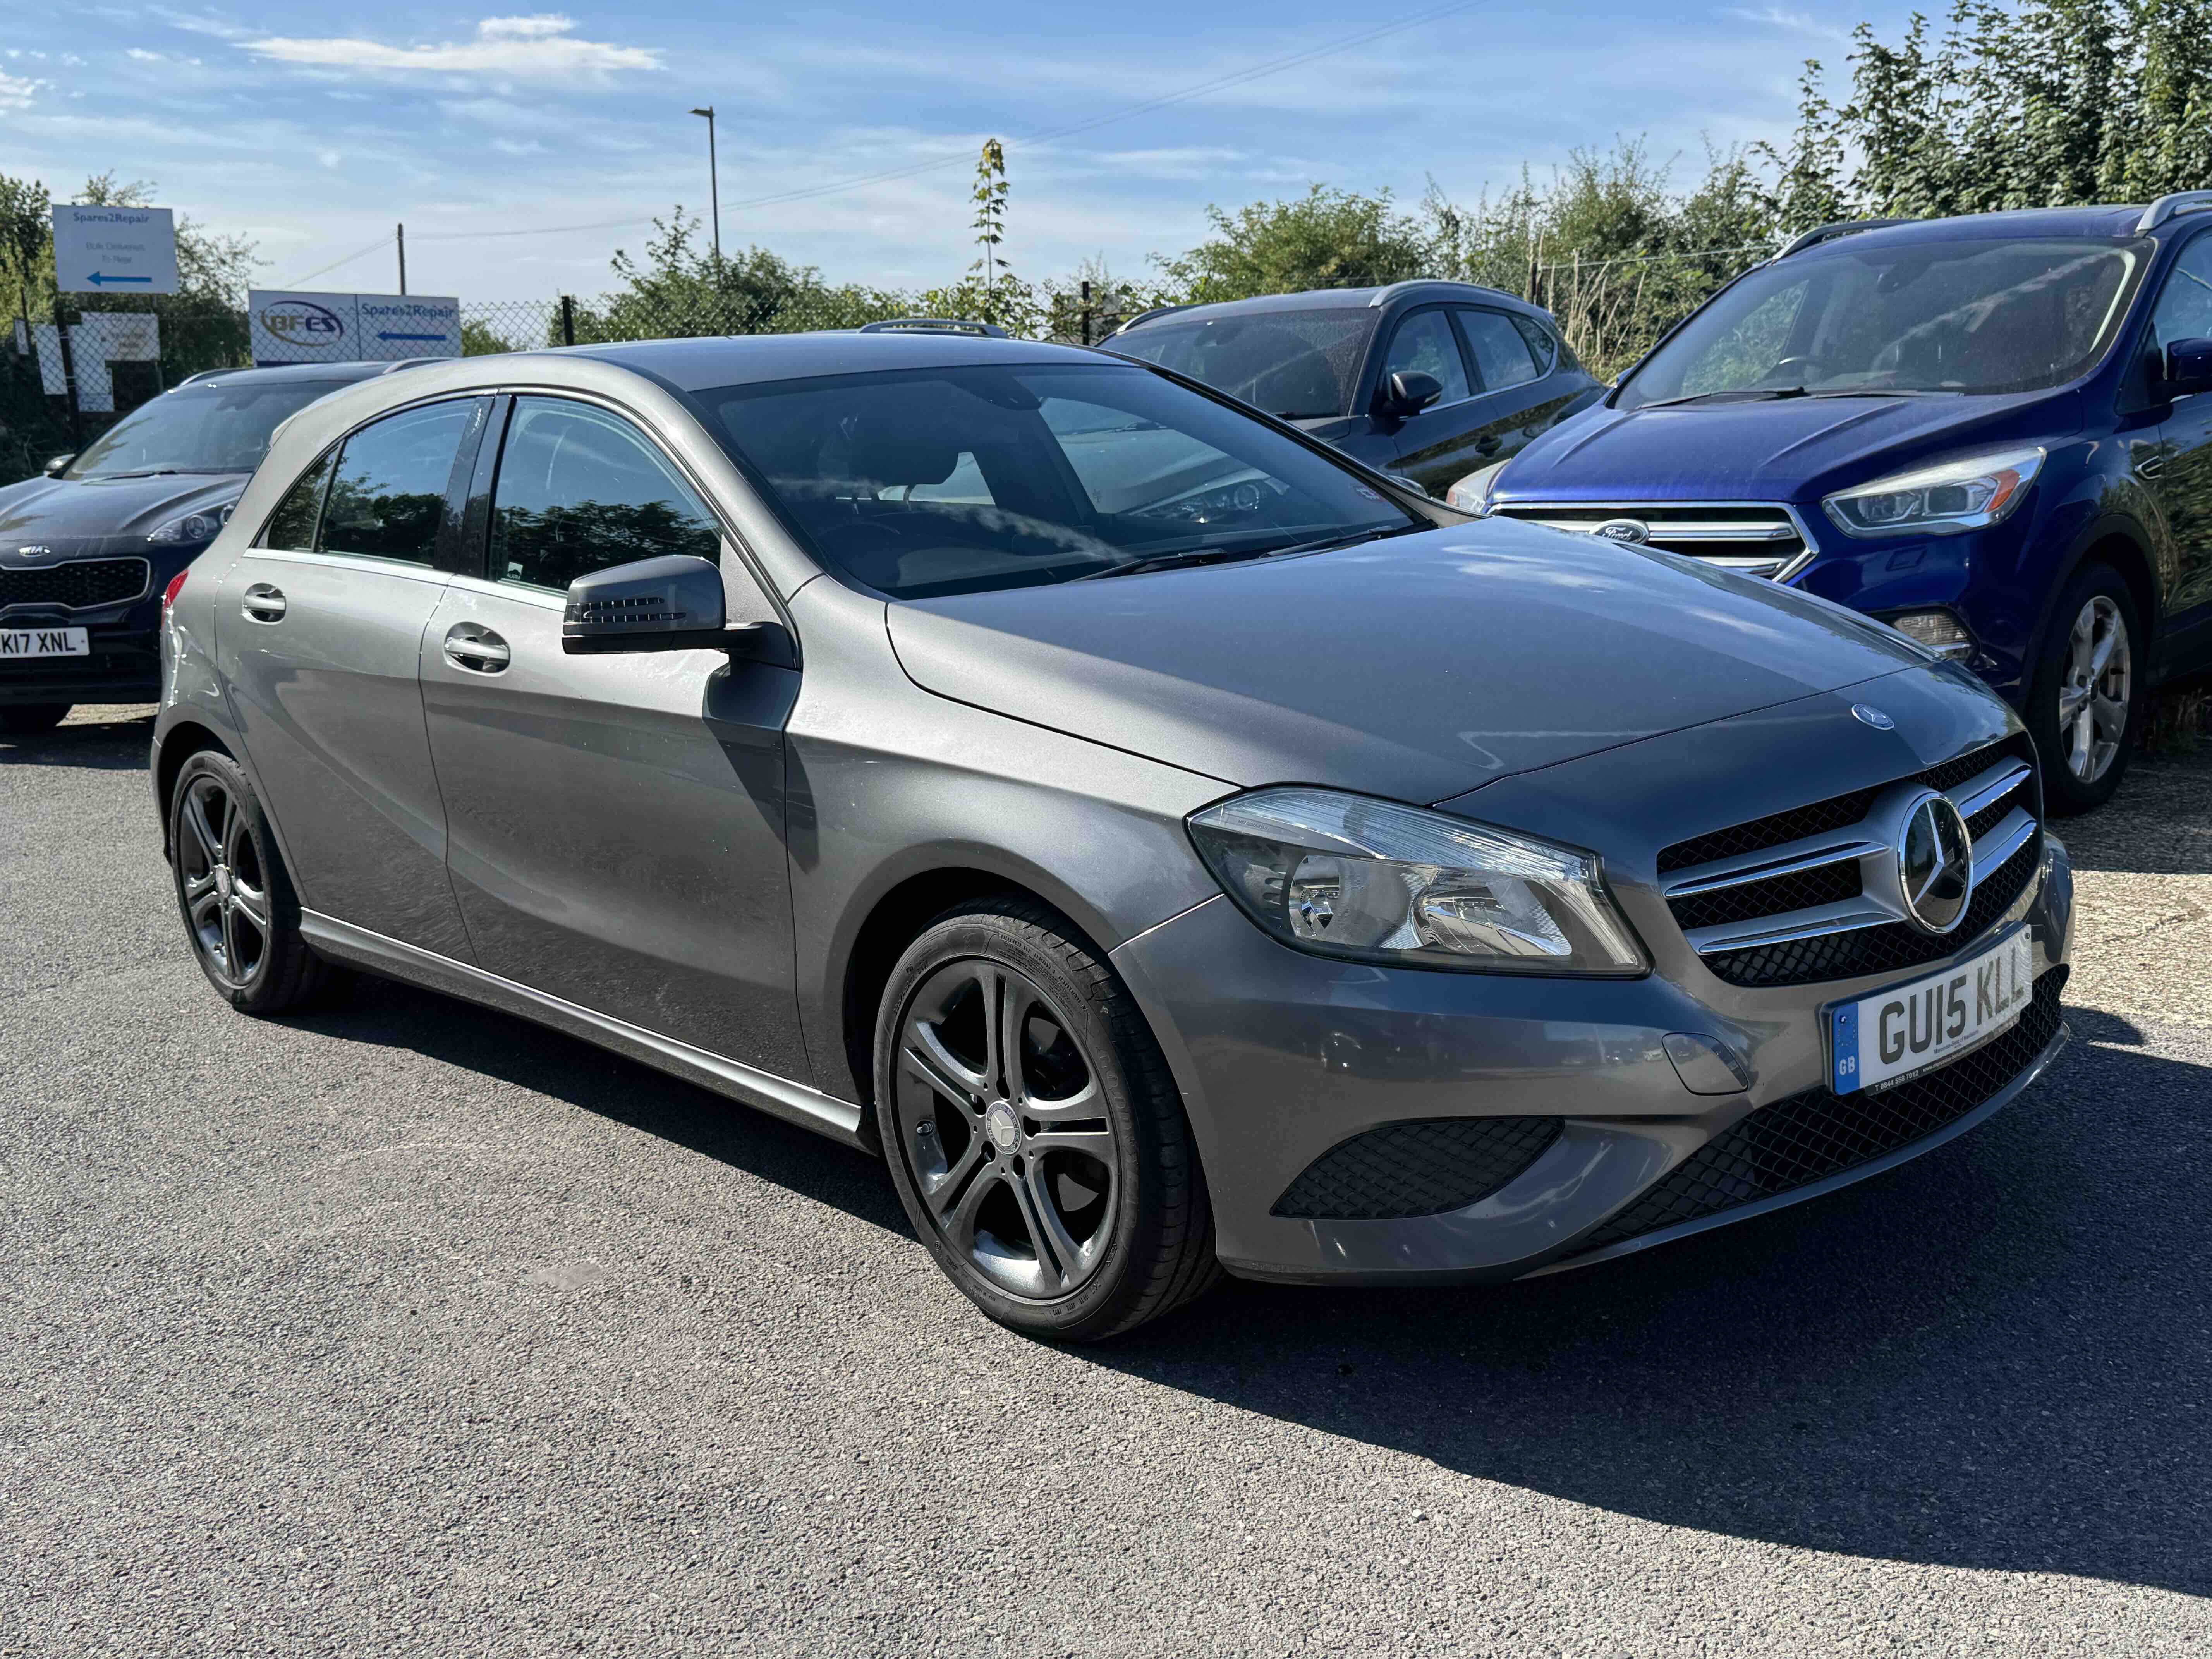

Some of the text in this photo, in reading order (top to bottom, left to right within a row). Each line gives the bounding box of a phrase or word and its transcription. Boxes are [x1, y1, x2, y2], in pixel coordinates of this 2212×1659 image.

[73, 211, 149, 225] Spares2Repair
[362, 303, 453, 321] Spares2Repair
[1603, 527, 1632, 541] Ford
[0, 632, 76, 653] K17 XNL
[1879, 974, 1967, 1065] GU15
[1977, 945, 2024, 1026] KLL
[1839, 1056, 1855, 1075] GB
[1880, 1079, 1894, 1089] 0844
[1906, 1070, 1919, 1080] 7012
[1006, 1108, 1019, 1145] MERCEDES
